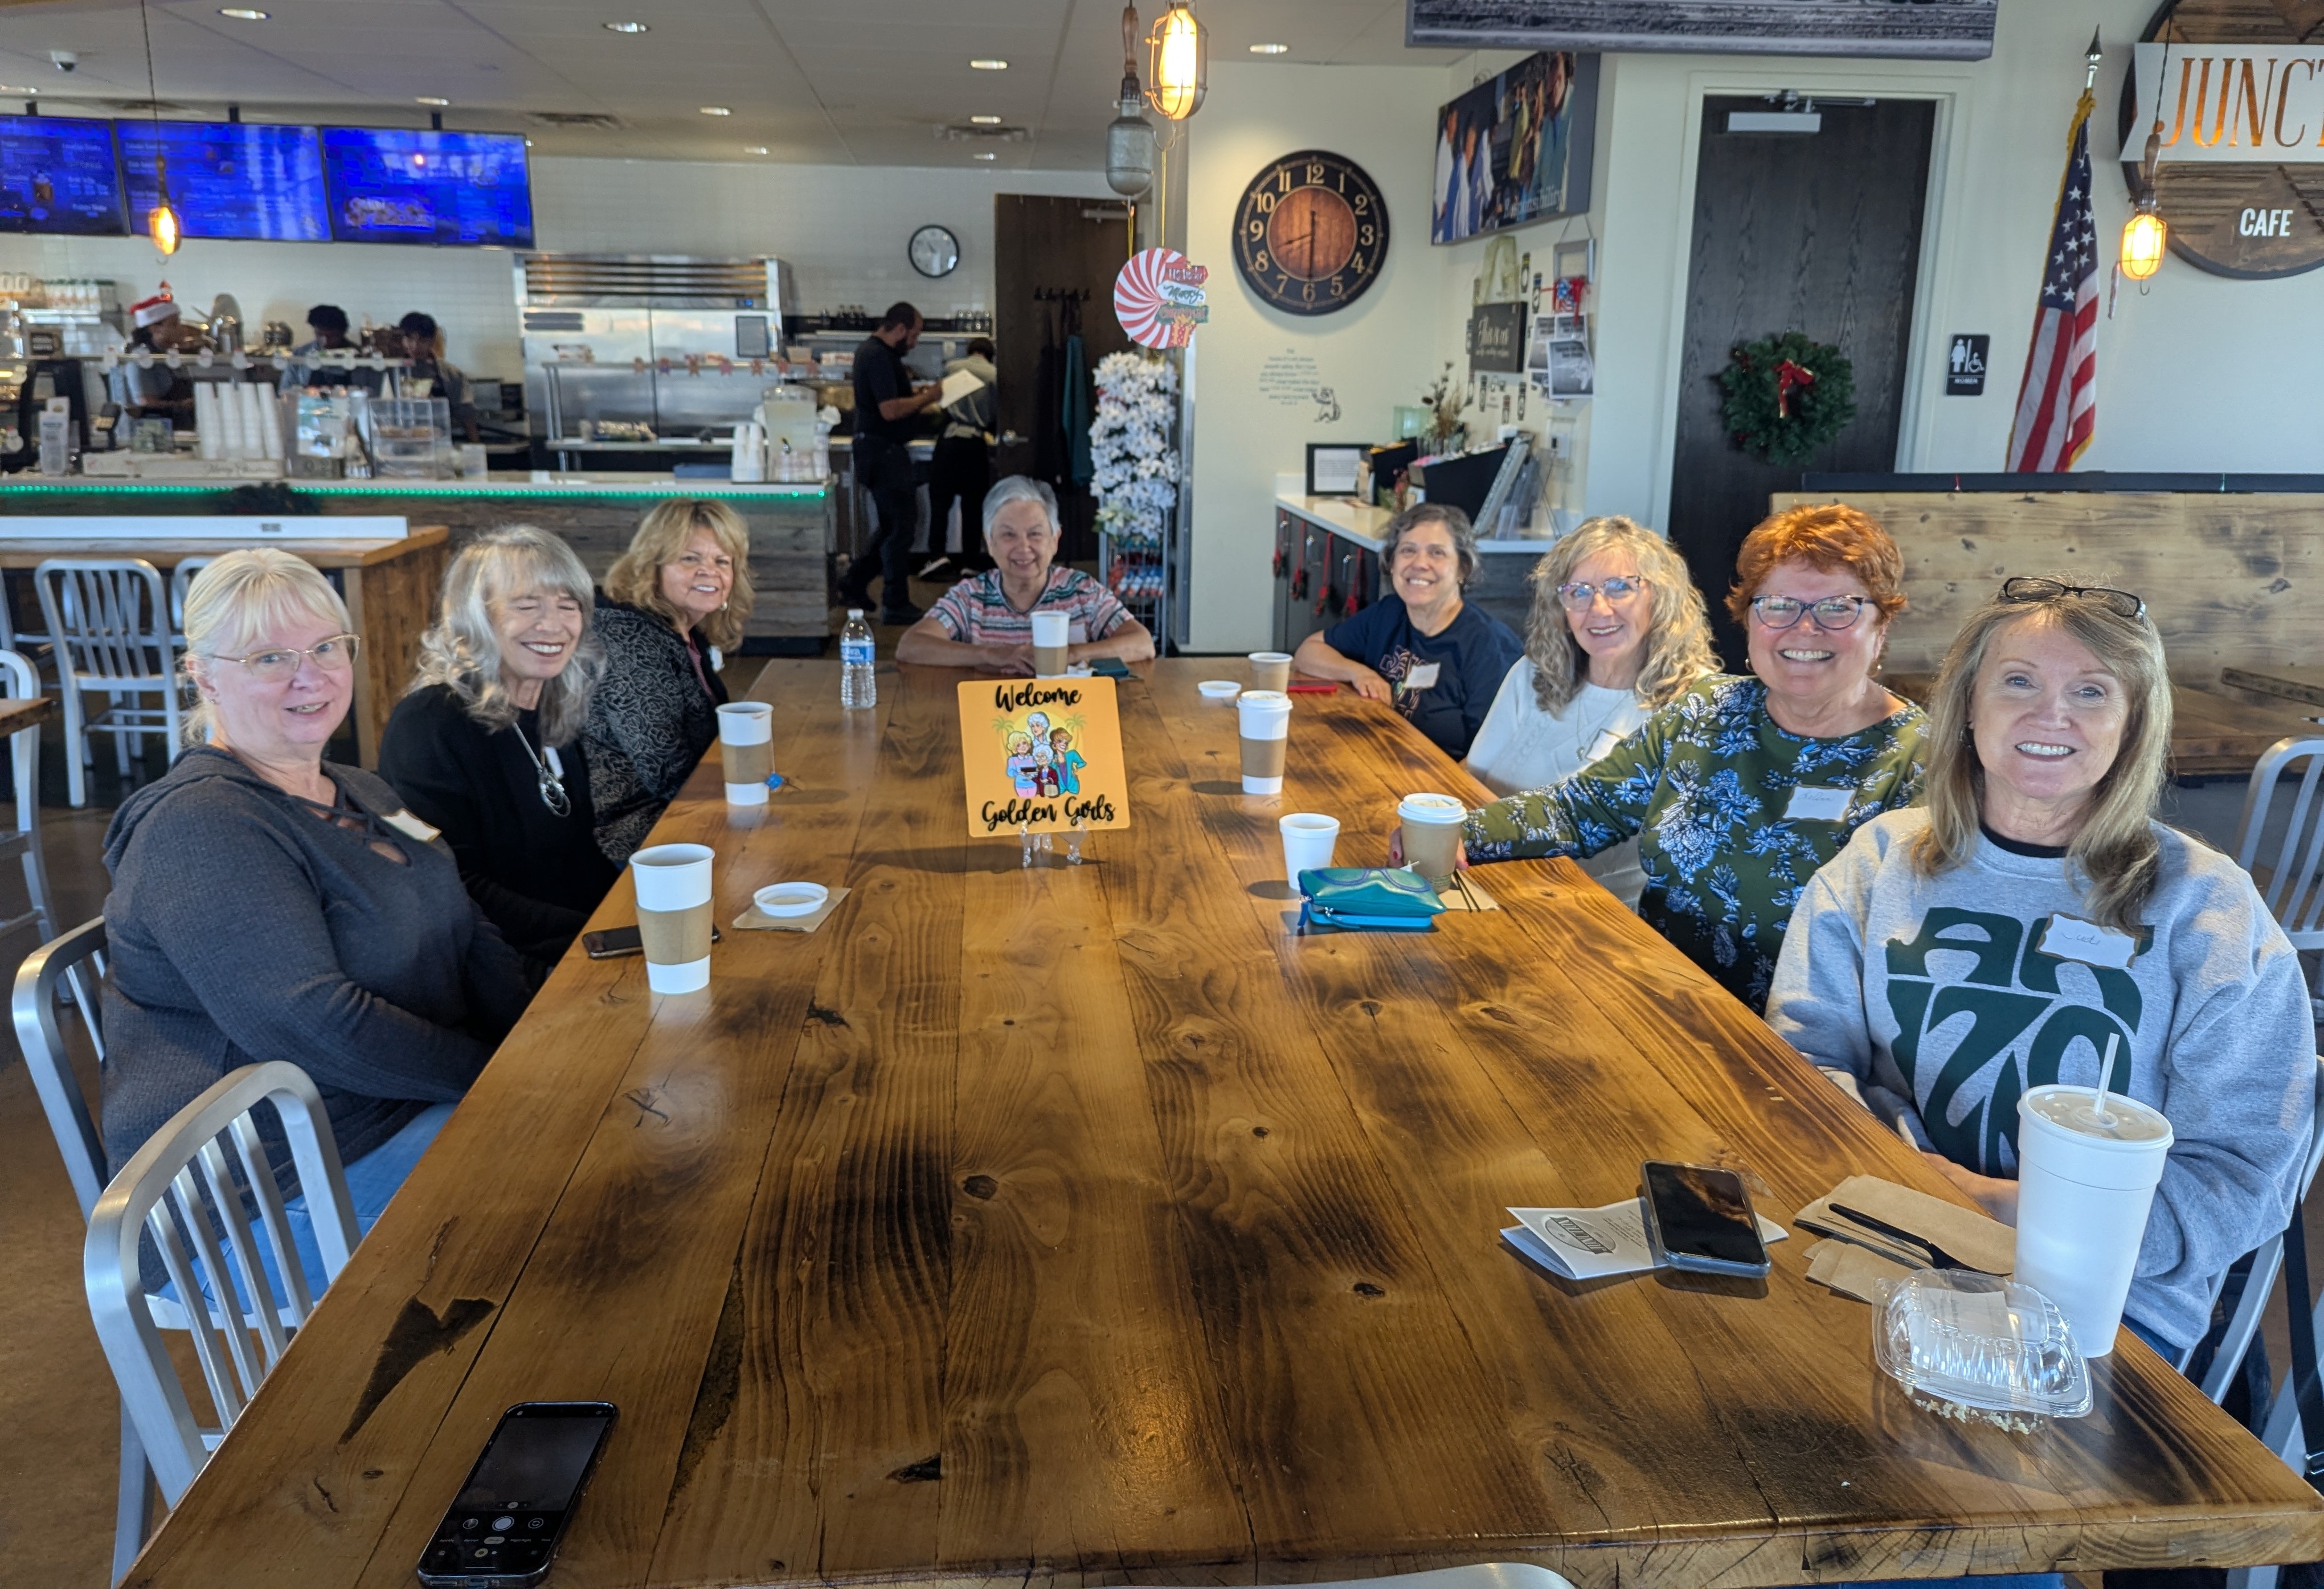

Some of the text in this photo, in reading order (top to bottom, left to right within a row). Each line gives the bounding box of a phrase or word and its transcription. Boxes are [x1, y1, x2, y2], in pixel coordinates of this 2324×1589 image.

[1278, 171, 1291, 192] 11
[1306, 163, 1325, 185] 12
[1339, 173, 1345, 193] 1
[1256, 191, 1275, 213] 10
[1355, 194, 1368, 215] 2
[1250, 219, 1264, 242] 9
[2239, 208, 2293, 237] CAFE
[1360, 224, 1374, 246] 3
[1254, 249, 1269, 272] 8
[1351, 252, 1365, 274] 4
[1163, 285, 1204, 305] Merry
[1276, 275, 1288, 294] 7
[1303, 282, 1316, 302] 6
[1330, 275, 1343, 296] 5
[995, 682, 1082, 712] Welcome
[982, 793, 1116, 832] Golden Girls
